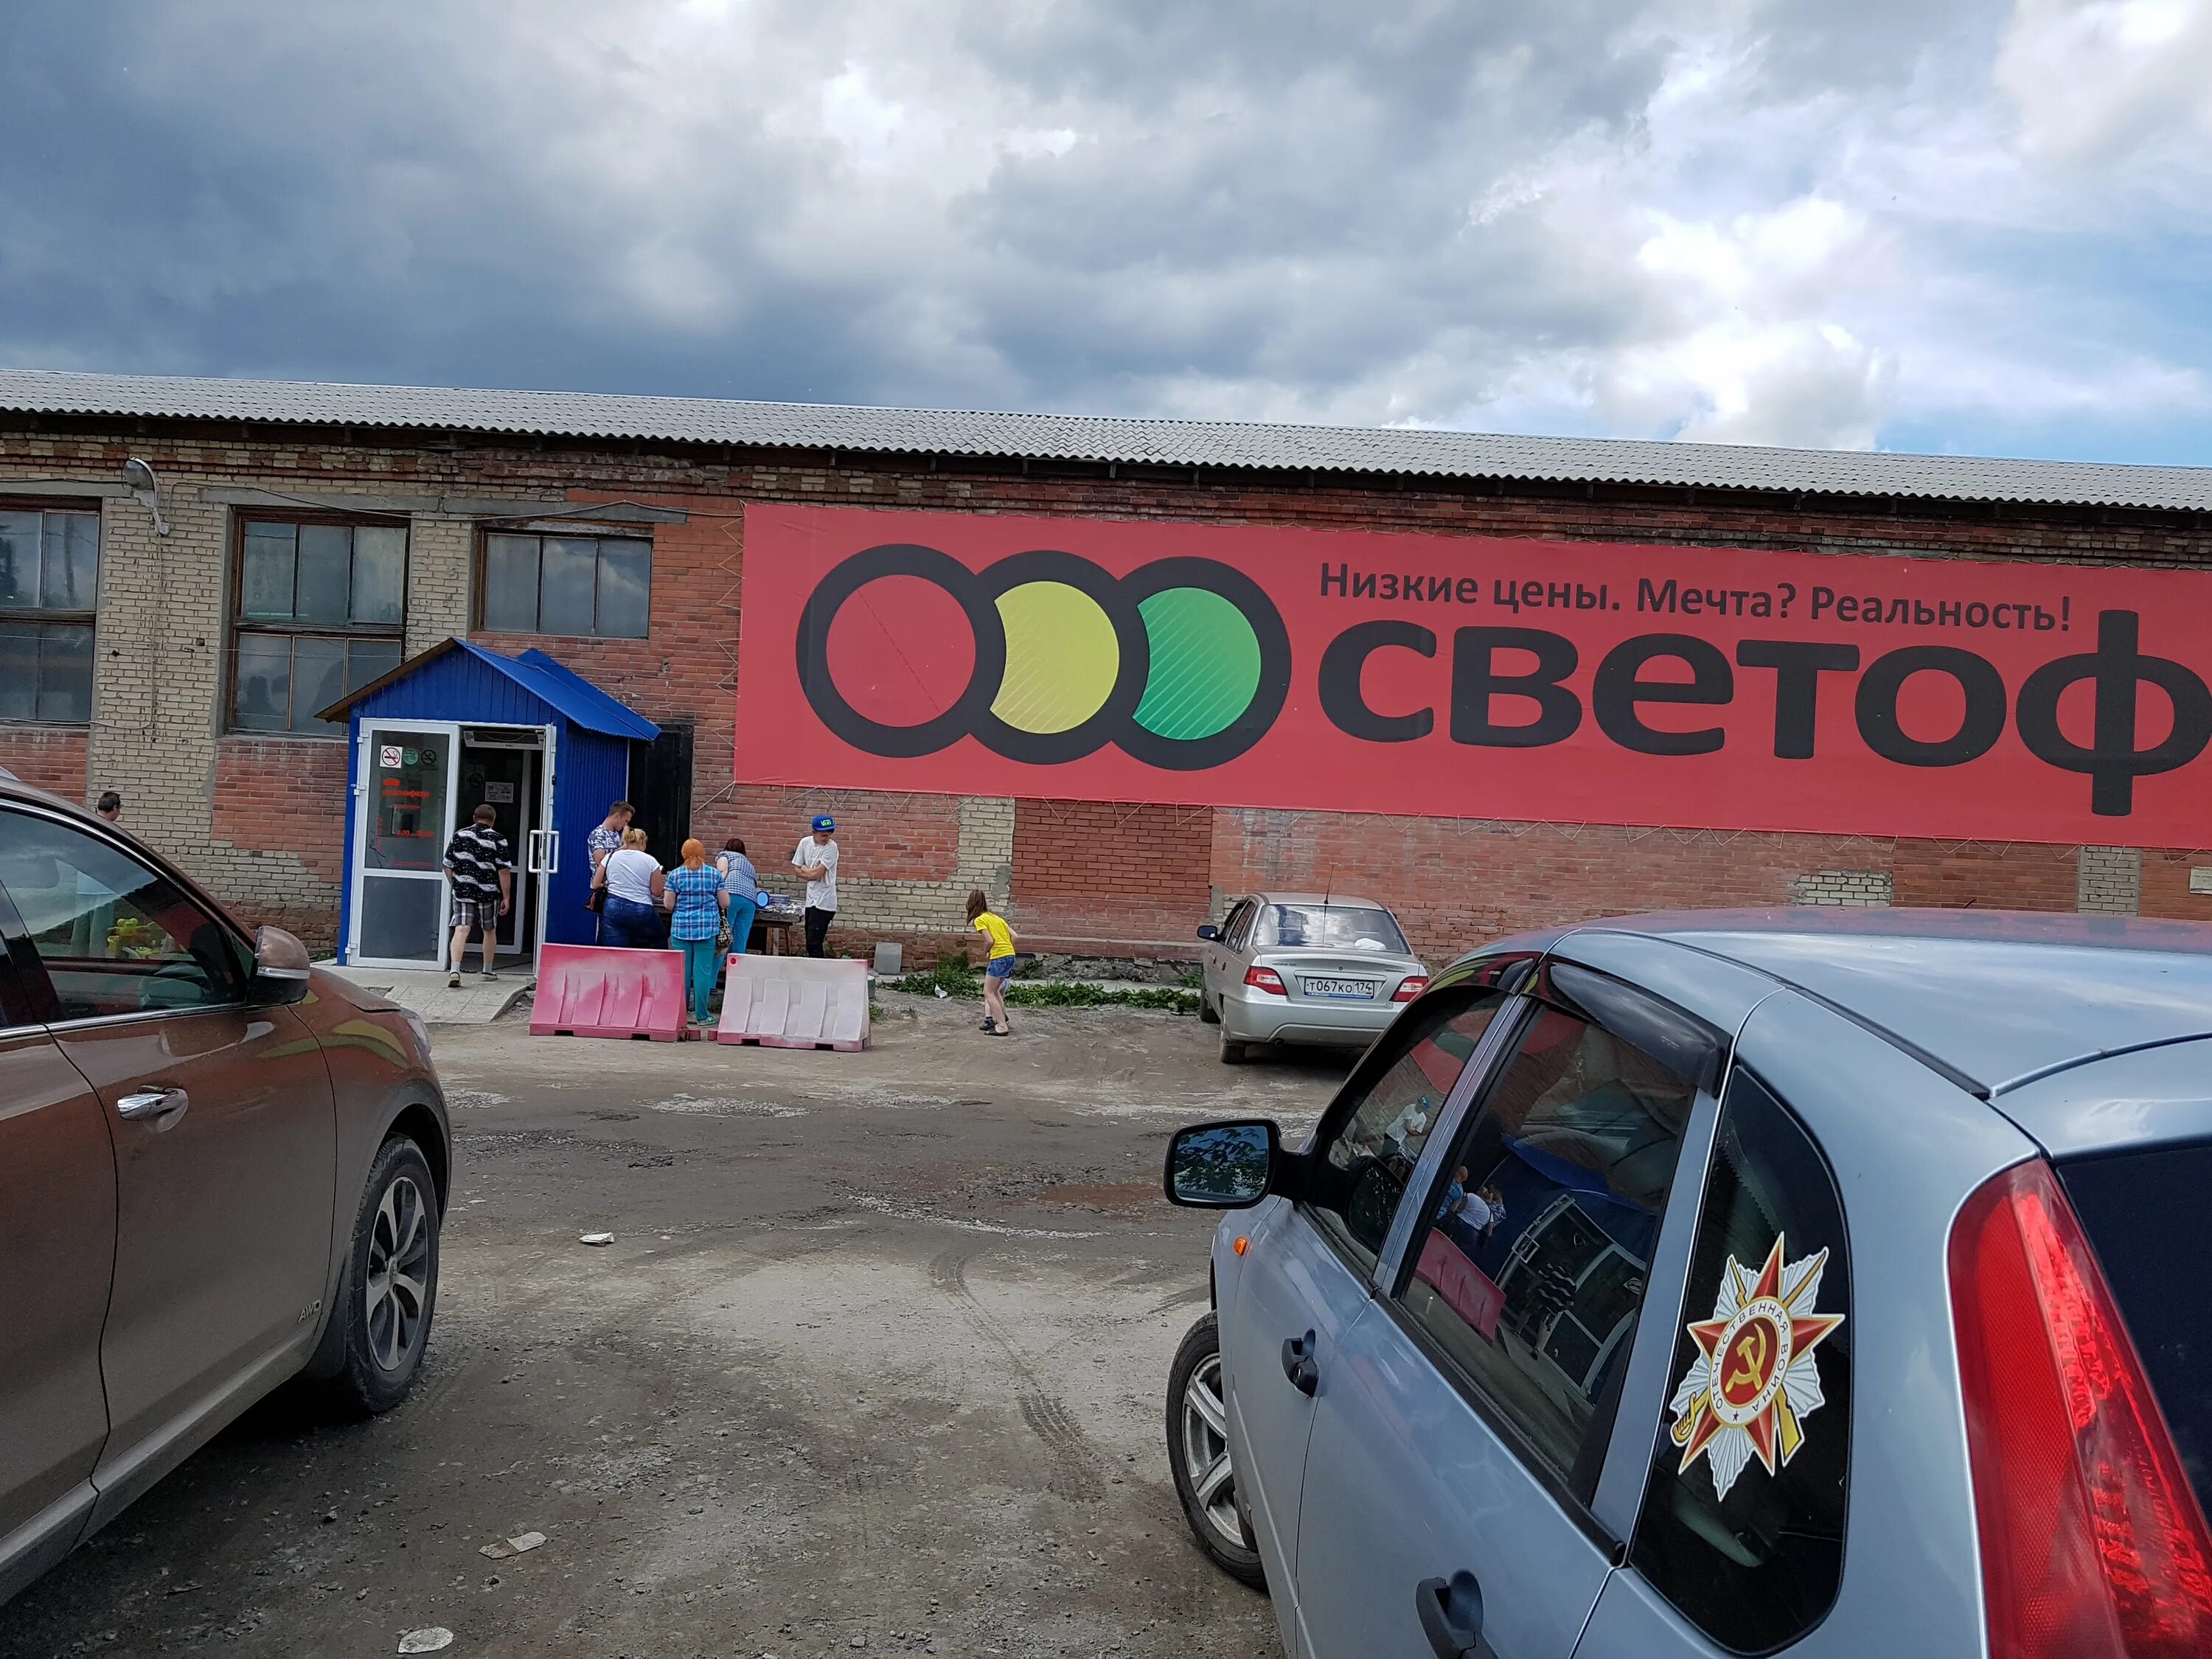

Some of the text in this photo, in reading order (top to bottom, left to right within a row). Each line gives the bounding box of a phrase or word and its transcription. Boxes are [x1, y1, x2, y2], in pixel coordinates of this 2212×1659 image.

[1321, 563, 2070, 631] Низкие цены. Мечта? Реальность!
[298, 1299, 321, 1324] AWD
[1712, 1302, 1788, 1411] ОТЕЧЕСТВЕННАЯ ВОЙНА
